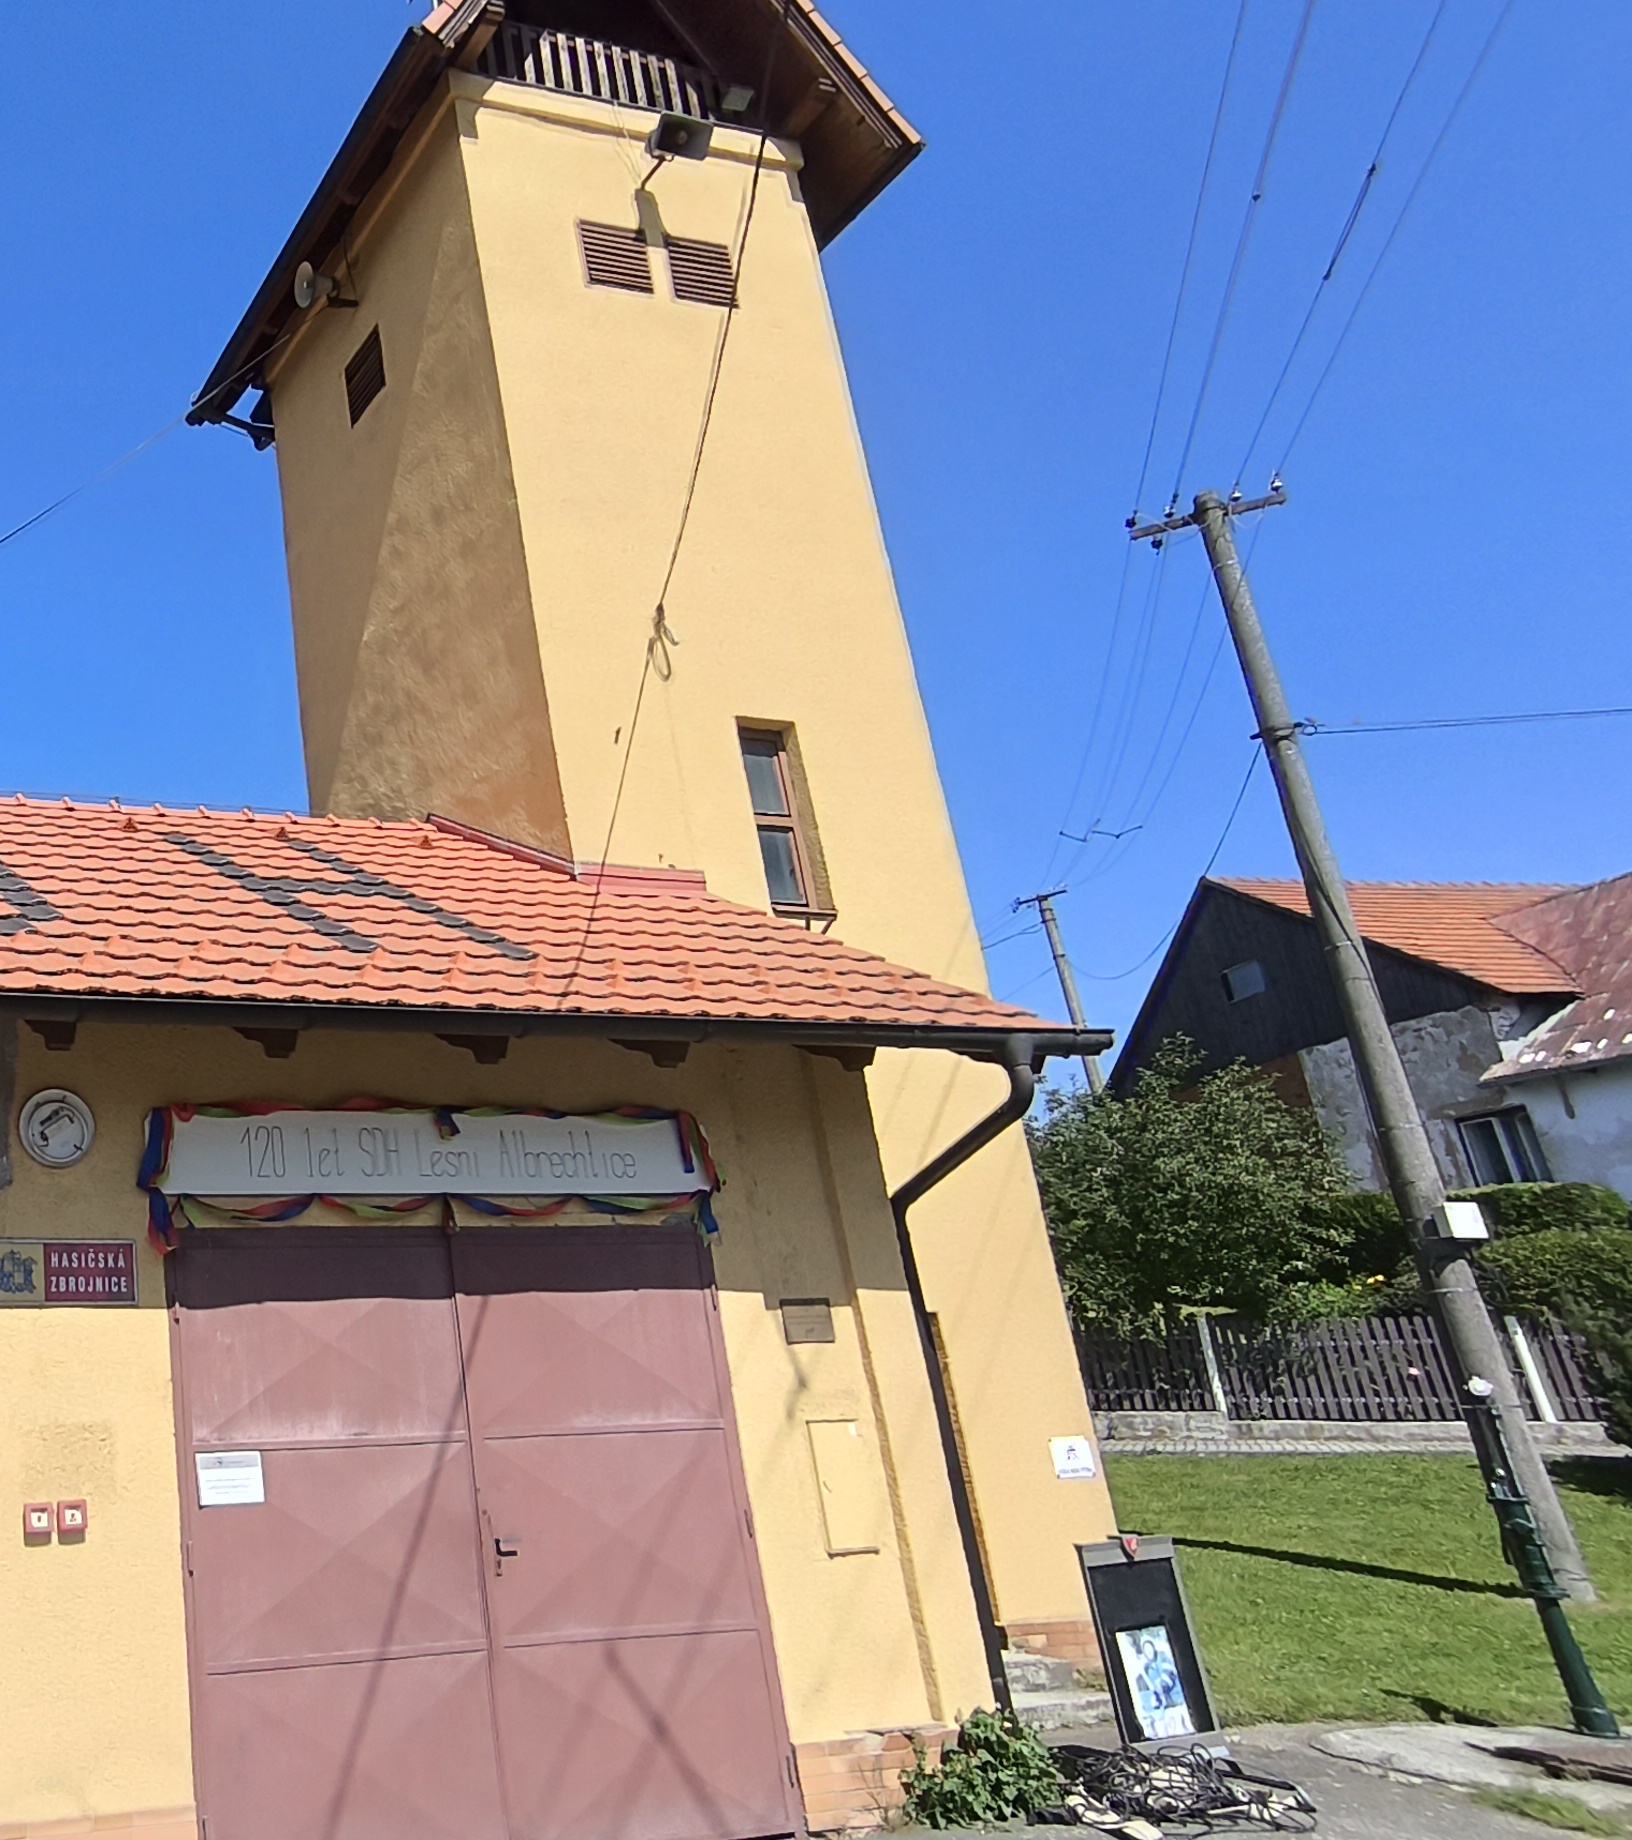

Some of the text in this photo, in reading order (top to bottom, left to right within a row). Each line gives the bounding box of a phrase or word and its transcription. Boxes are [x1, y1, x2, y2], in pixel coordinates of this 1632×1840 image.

[240, 1125, 286, 1178] 120
[358, 1126, 403, 1178] SDH
[50, 1249, 125, 1268] HASIČSKÁ
[50, 1276, 128, 1293] ZBROJNICE
